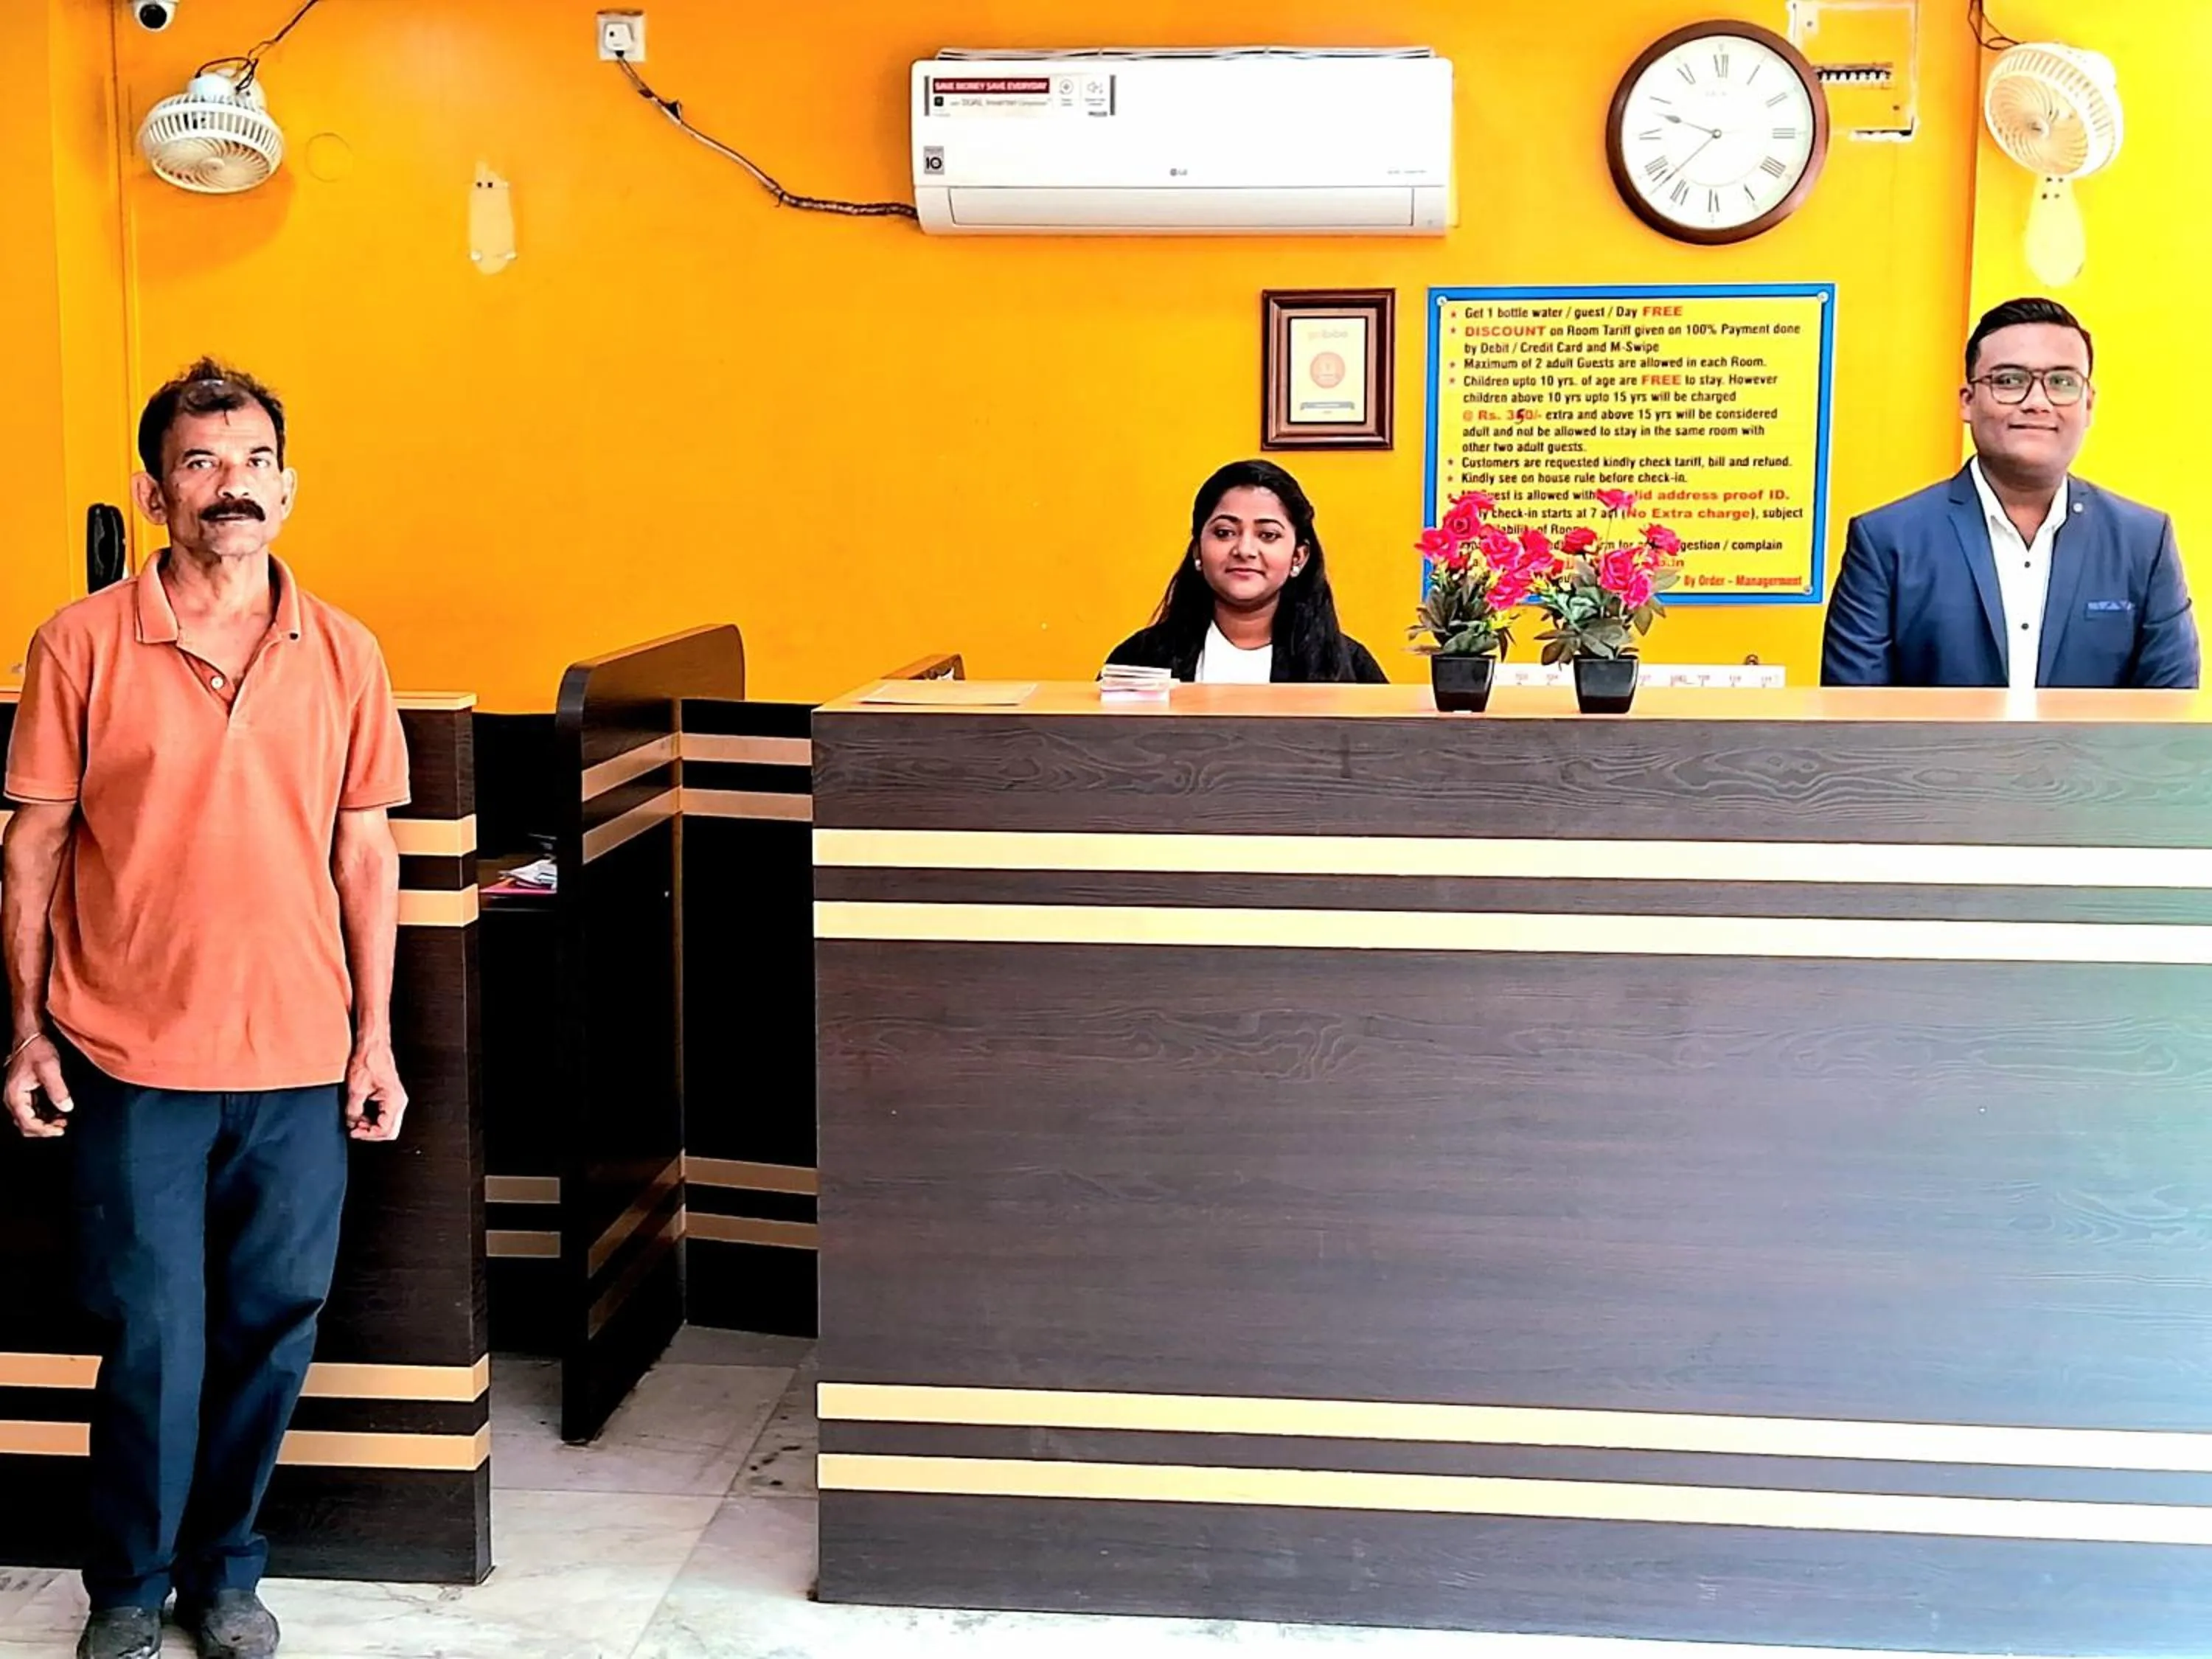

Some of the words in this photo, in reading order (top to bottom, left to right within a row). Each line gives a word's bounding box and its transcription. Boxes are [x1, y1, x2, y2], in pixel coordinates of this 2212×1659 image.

[1464, 307, 1484, 319] Get
[1487, 307, 1493, 319] 1
[1498, 307, 1528, 319] bottle
[1531, 307, 1563, 319] water
[1565, 307, 1572, 319] /
[1573, 307, 1605, 320] guest
[1607, 306, 1613, 318] /
[1615, 305, 1638, 319] Day
[1642, 306, 1683, 317] FREE
[1464, 325, 1546, 337] DISCOUNT
[1549, 327, 1564, 337] on
[1566, 324, 1599, 336] Room
[1602, 324, 1631, 336] Tariff
[1634, 326, 1664, 338] given
[1667, 326, 1682, 335] on
[1686, 324, 1717, 335] 100%
[1720, 323, 1770, 337] Payment
[1773, 323, 1801, 335] done
[1464, 343, 1478, 356] by
[1480, 341, 1509, 355] Debit
[1512, 343, 1518, 353] /
[1520, 341, 1554, 353] Credit
[1557, 341, 1583, 353] Card
[1585, 341, 1607, 353] and
[1610, 341, 1660, 355] M-Swipe
[1464, 358, 1518, 369] Maximum
[1521, 358, 1532, 369] of
[1535, 357, 1543, 369] 2
[1546, 358, 1573, 369] adult
[1576, 356, 1614, 369] Guests
[1618, 359, 1637, 369] are
[1640, 357, 1683, 369] allowed
[1686, 358, 1697, 368] in
[1700, 356, 1728, 368] each
[1463, 375, 1509, 387] Children
[1512, 375, 1537, 389] upto
[1540, 375, 1554, 386] 10
[1581, 375, 1592, 386] of
[1595, 377, 1615, 389] age
[1618, 377, 1638, 386] are
[1641, 374, 1682, 386] FREE
[1685, 375, 1696, 386] to
[1728, 374, 1778, 386] However
[1463, 392, 1508, 403] children
[1510, 392, 1544, 403] above
[1548, 392, 1562, 403] 10
[1565, 393, 1582, 405] yrs
[1585, 392, 1610, 405] upto
[1613, 391, 1627, 403] 15
[1630, 393, 1647, 405] yrs
[1650, 391, 1671, 402] will
[1674, 391, 1688, 403] be
[1691, 390, 1737, 405] charged
[1545, 409, 1573, 421] extra
[1576, 408, 1598, 420] and
[1600, 408, 1635, 420] above
[1638, 408, 1652, 420] 15
[1655, 411, 1672, 422] yrs
[1675, 408, 1695, 420] will
[1698, 408, 1713, 420] be
[1715, 408, 1778, 420] considered
[1462, 425, 1490, 437] adult
[1492, 425, 1513, 437] and
[1516, 425, 1534, 437] not
[1537, 425, 1551, 437] be
[1554, 425, 1596, 437] allowed
[1599, 425, 1611, 437] to
[1613, 425, 1638, 439] stay
[1640, 425, 1651, 437] in
[1654, 425, 1672, 437] the
[1674, 427, 1705, 437] same
[1708, 427, 1738, 437] room
[1741, 424, 1765, 436] with
[1461, 442, 1491, 453] other
[1493, 442, 1514, 453] two
[1516, 441, 1544, 453] adult
[1461, 456, 1520, 469] Customers
[1523, 458, 1542, 468] are
[1544, 456, 1599, 470] requested
[1603, 456, 1635, 470] kindly
[1638, 456, 1672, 468] check
[1708, 456, 1725, 467] bill
[1728, 456, 1749, 467] and
[1461, 472, 1495, 486] Kindly
[1498, 474, 1517, 484] see
[1520, 473, 1535, 484] on
[1537, 472, 1571, 484] house
[1573, 472, 1596, 484] rule
[1599, 472, 1635, 484] before
[1483, 490, 1511, 500] est
[1513, 489, 1523, 501] is
[1526, 489, 1569, 501] allowed
[1572, 490, 1596, 499] with
[1629, 490, 1653, 500] lid
[1657, 490, 1719, 501] address
[1722, 489, 1764, 503] proof
[1492, 507, 1538, 519] check-in
[1541, 508, 1573, 519] starts
[1575, 507, 1587, 519] at
[1590, 507, 1597, 518] 7
[1652, 507, 1693, 519] Extra
[1697, 507, 1759, 521] charge),
[1762, 507, 1804, 521] subject
[1679, 540, 1720, 552] gestion
[1722, 540, 1728, 551] /
[1731, 539, 1783, 553] complain
[1683, 574, 1695, 588] By
[1698, 574, 1726, 586] Order
[1735, 574, 1803, 588] Management
